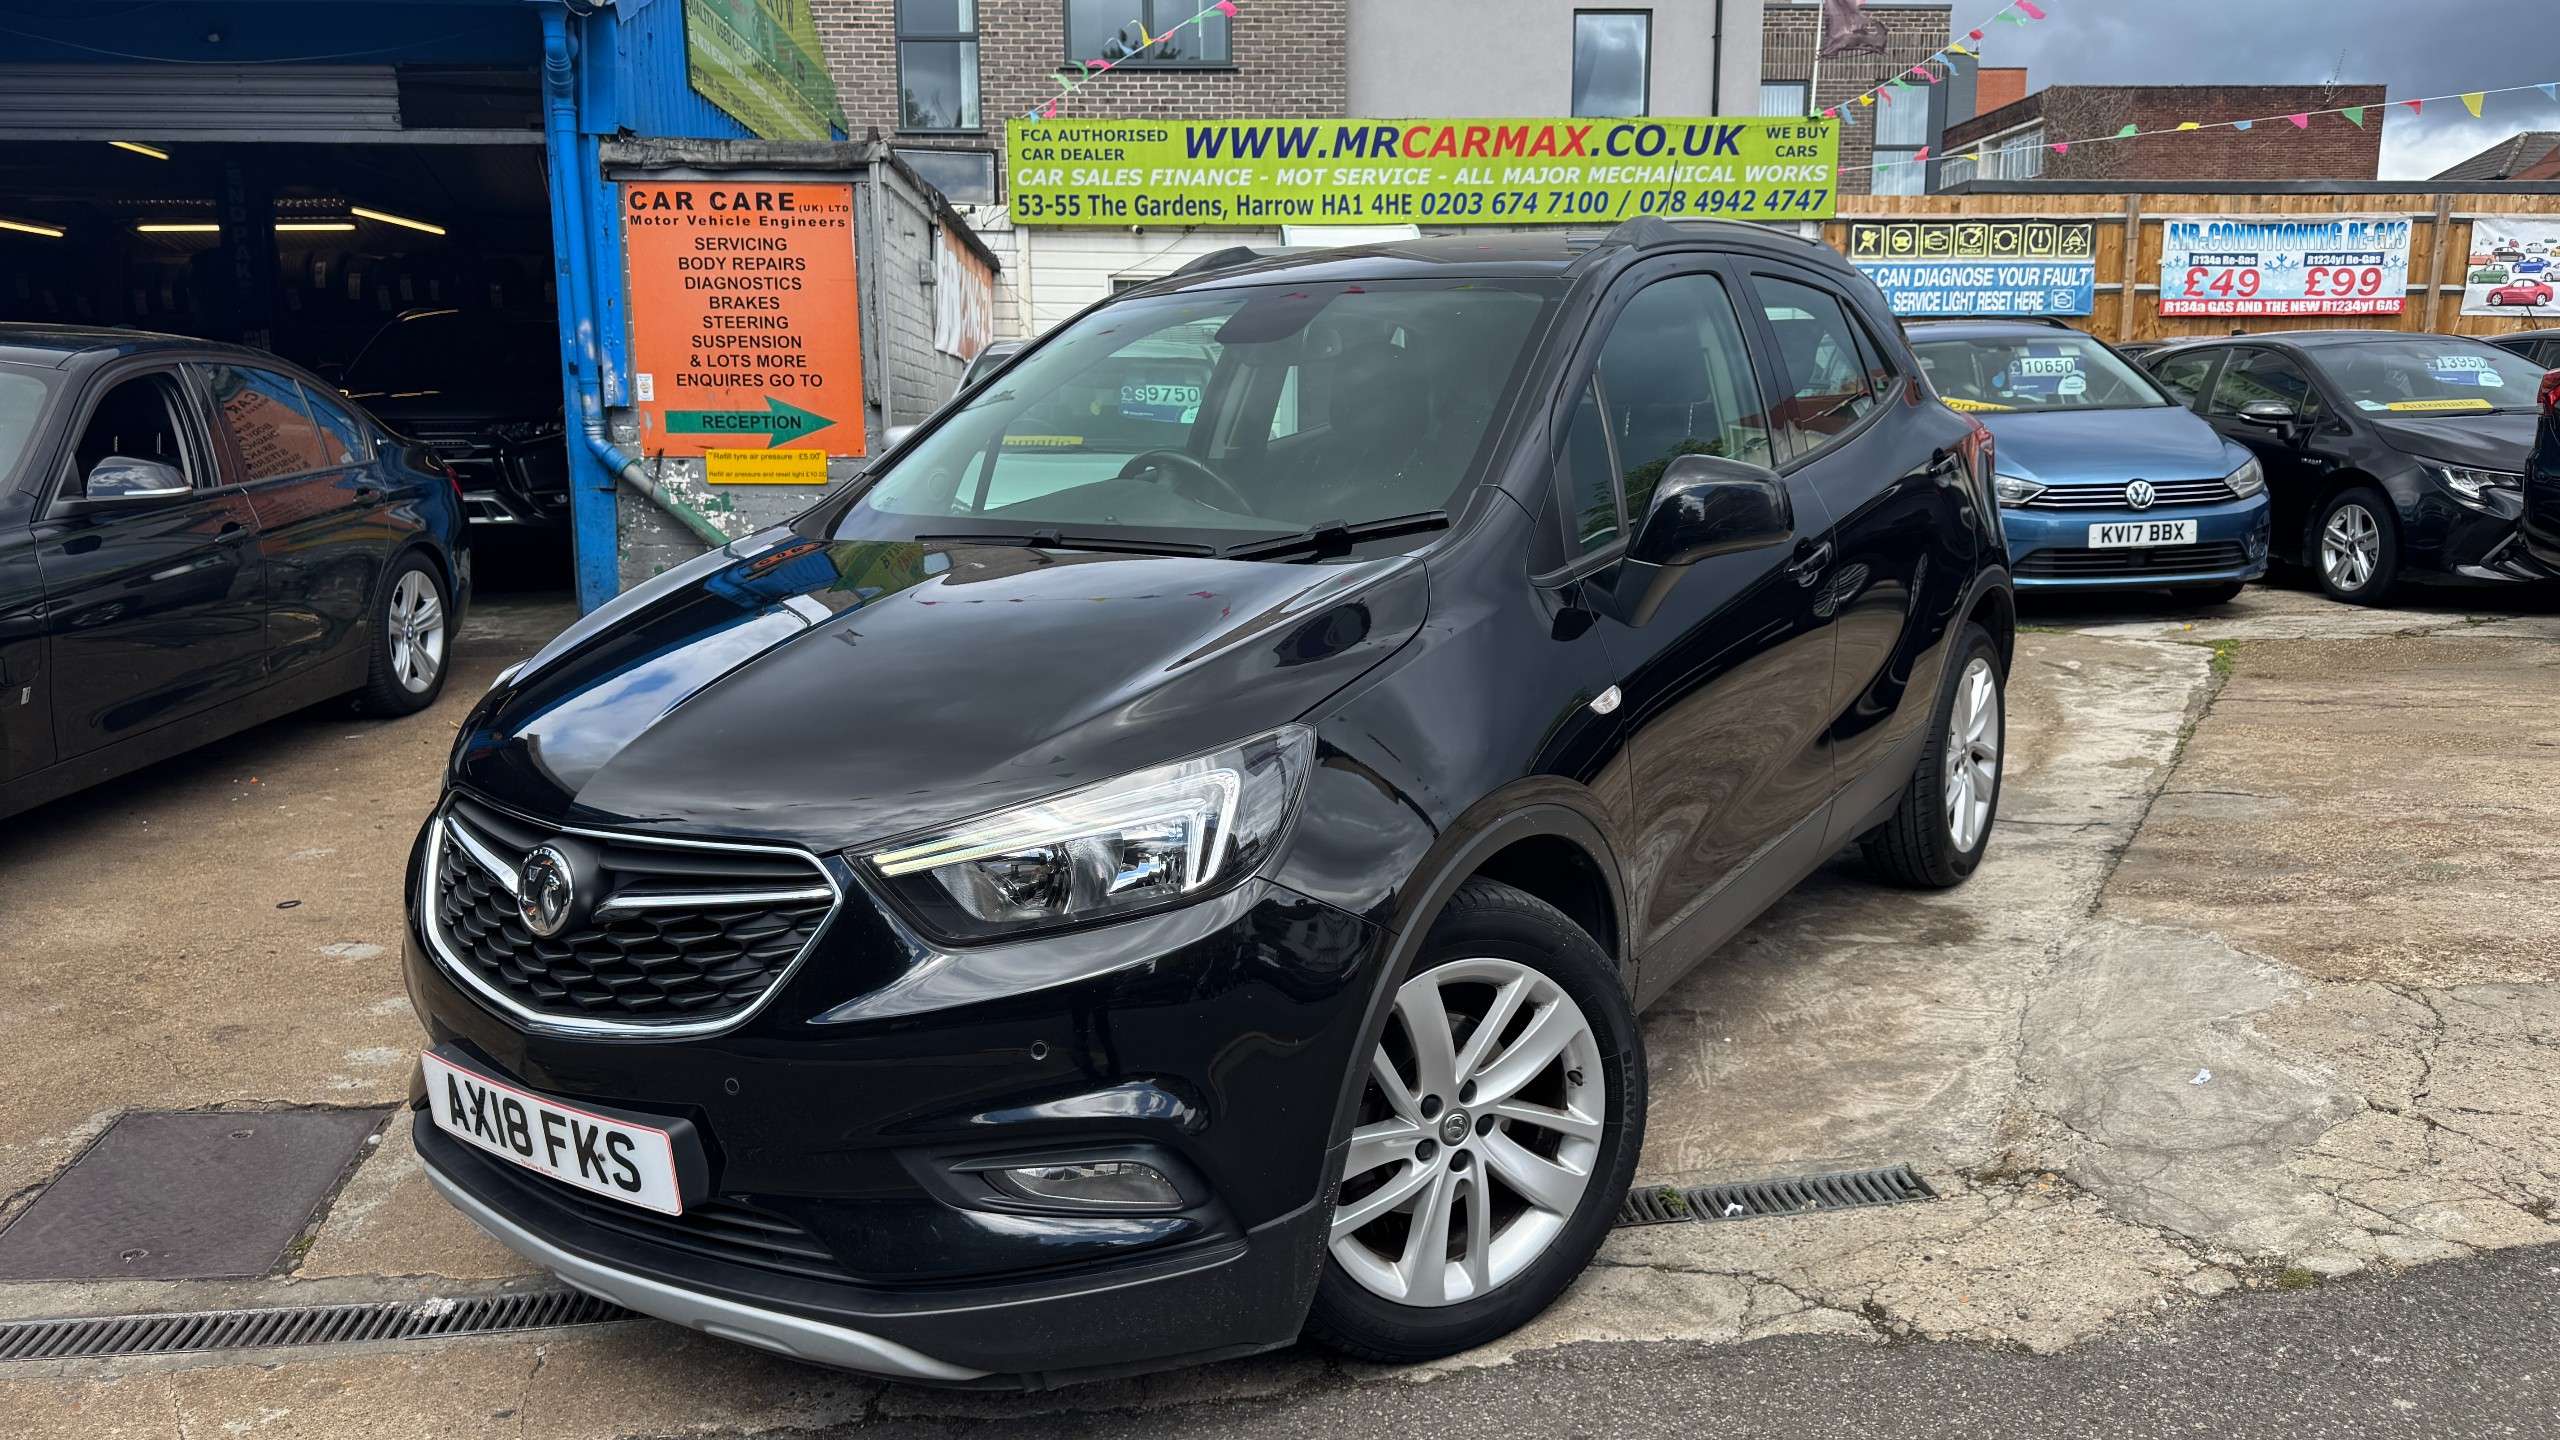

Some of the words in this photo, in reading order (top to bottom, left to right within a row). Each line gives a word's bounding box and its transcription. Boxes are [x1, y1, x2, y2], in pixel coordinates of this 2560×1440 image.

[1021, 129, 1053, 142] FCA
[1056, 129, 1169, 142] AUTHORISED
[1766, 127, 1792, 139] WE
[1796, 126, 1830, 139] BUY
[1185, 124, 1747, 159] WWW.MRCARMAX.CO.UK
[1021, 148, 1057, 161] CAR
[1061, 148, 1125, 161] DEALER
[1775, 145, 1818, 158] CARS
[1017, 168, 1064, 186] CAR
[1070, 168, 1143, 186] SALES
[1149, 167, 1253, 186] FINANCE
[1276, 168, 1328, 186] MOT
[1332, 167, 1432, 186] SERVICE
[1453, 167, 1495, 185] ALL
[1502, 166, 1580, 185] MAJOR
[1587, 165, 1736, 184] MECHANICAL
[1745, 164, 1829, 182] WORKS
[630, 191, 694, 211] CAR
[709, 191, 796, 212] CARE
[799, 204, 824, 214] (UK)
[828, 205, 849, 213] LTD
[1018, 194, 1081, 217] 53-55
[1087, 193, 1128, 217] The
[1134, 193, 1229, 221] Gardens,
[1236, 193, 1314, 216] Harrow
[1322, 193, 1364, 216] HA1
[1371, 192, 1413, 215] 4HE
[1421, 192, 1483, 216] 0203
[1491, 191, 1539, 215] 674
[1546, 191, 1610, 214] 7100
[1639, 190, 1686, 213] 078
[1693, 189, 1756, 212] 4942
[1763, 189, 1829, 212] 4747
[630, 215, 680, 226] Motor
[687, 215, 751, 226] Vehicle
[759, 216, 846, 229] Engineers
[2168, 222, 2343, 251] AIR-CONDITIONING
[2347, 221, 2408, 250] RE-GAS
[694, 237, 788, 251] SERVICING
[678, 257, 727, 271] BODY
[732, 257, 806, 271] REPAIRS
[2222, 255, 2257, 265] Re-Gas
[684, 277, 802, 291] DIAGNOSTICS
[1877, 268, 1913, 287] CAN
[1913, 267, 1997, 288] DIAGNOSE
[1998, 267, 2043, 287] YOUR
[2043, 266, 2089, 286] FAULT
[2183, 267, 2261, 298] £49
[2304, 267, 2382, 297] £99
[709, 296, 780, 310] BRAKES
[1893, 291, 1943, 312] SERVICE
[1943, 290, 1976, 311] LIGHT
[1976, 290, 2014, 311] RESET
[2014, 290, 2044, 311] HERE
[2164, 301, 2206, 313] R134a
[2207, 301, 2235, 312] GAS
[2235, 301, 2263, 312] AND
[2265, 301, 2289, 312] THE
[2290, 300, 2320, 312] NEW
[2376, 299, 2401, 311] GAS
[703, 316, 789, 330] STEERING
[691, 335, 802, 349] SUSPENSION
[690, 355, 702, 368] &
[707, 354, 751, 368] LOTS
[756, 354, 807, 368] MORE
[676, 374, 763, 388] ENQUIRES
[769, 374, 795, 387] GO
[799, 374, 823, 387] TO
[702, 415, 802, 429] RECEPTION
[2101, 525, 2144, 544] KV17
[2149, 523, 2186, 542] BBX
[447, 1072, 534, 1157] AX18
[540, 1109, 642, 1193] FKS
